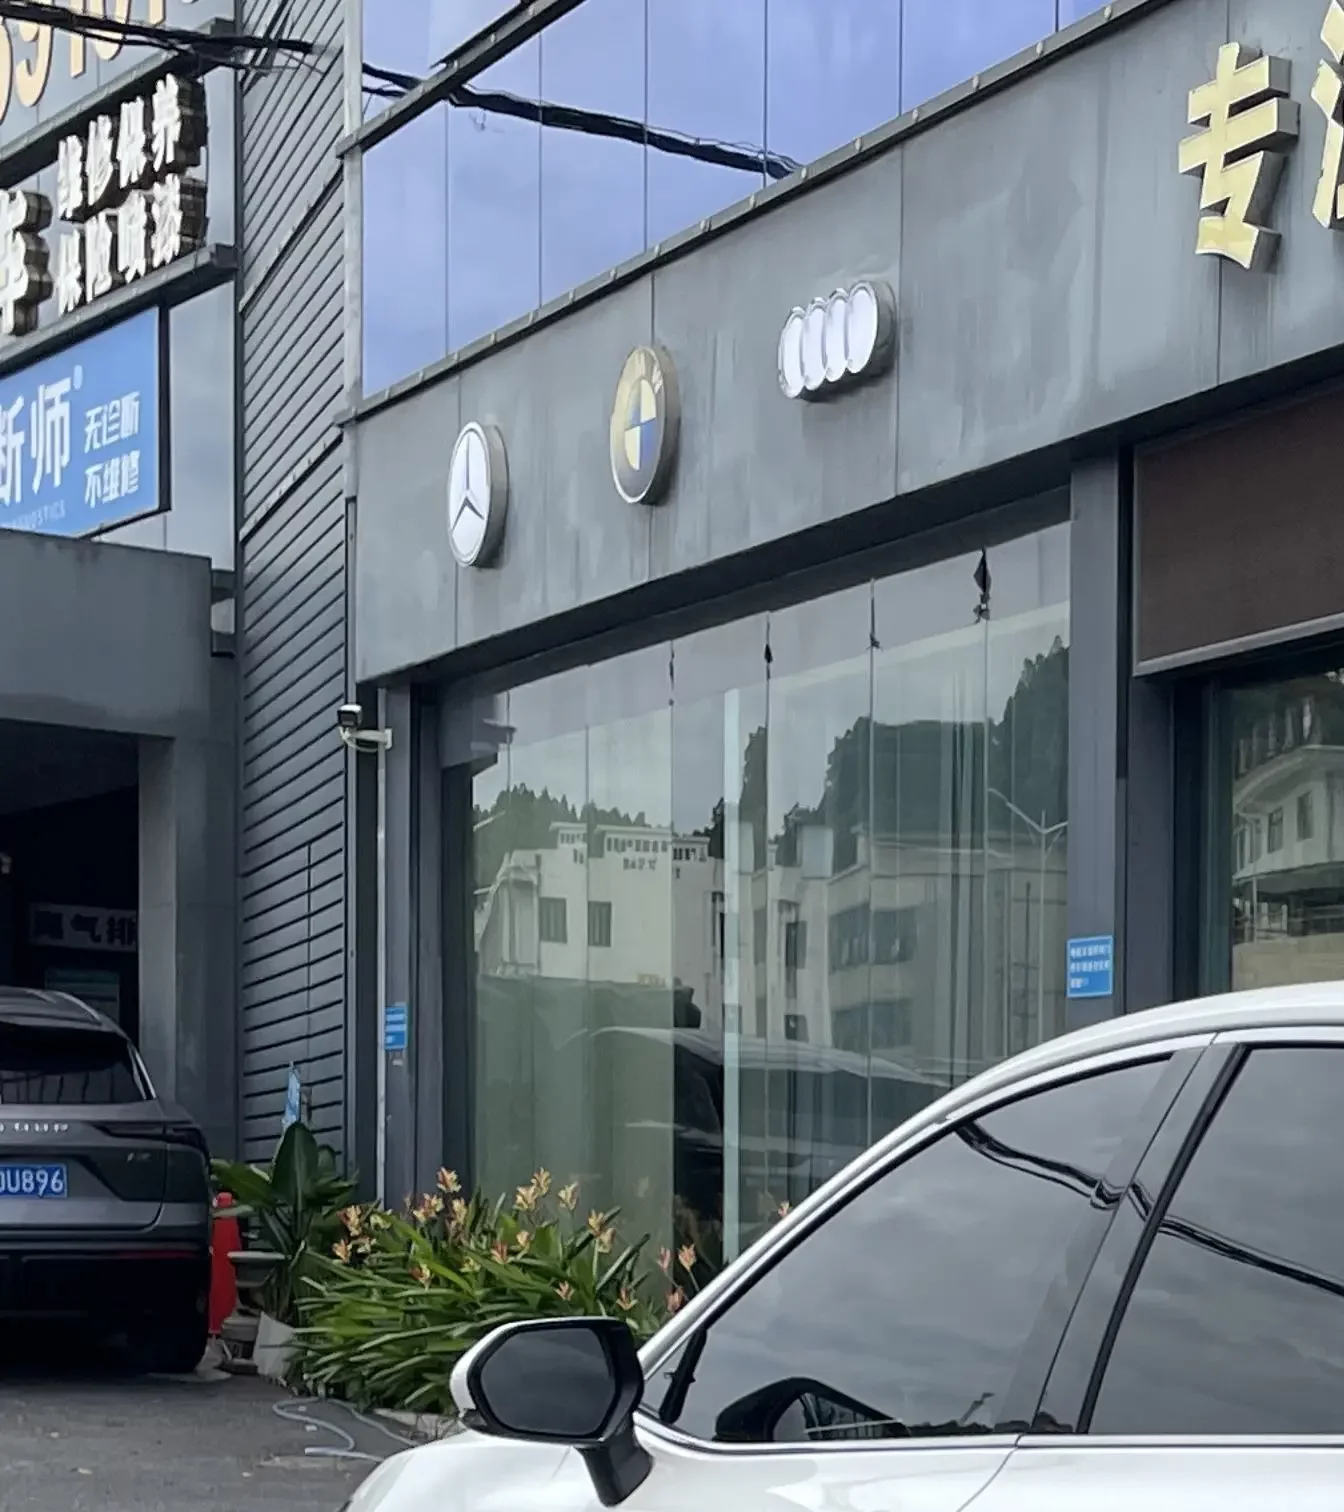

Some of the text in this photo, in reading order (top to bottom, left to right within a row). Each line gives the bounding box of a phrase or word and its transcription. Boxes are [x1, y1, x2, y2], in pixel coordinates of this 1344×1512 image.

[84, 391, 141, 454] 无诊断
[84, 450, 141, 510] 不维修
